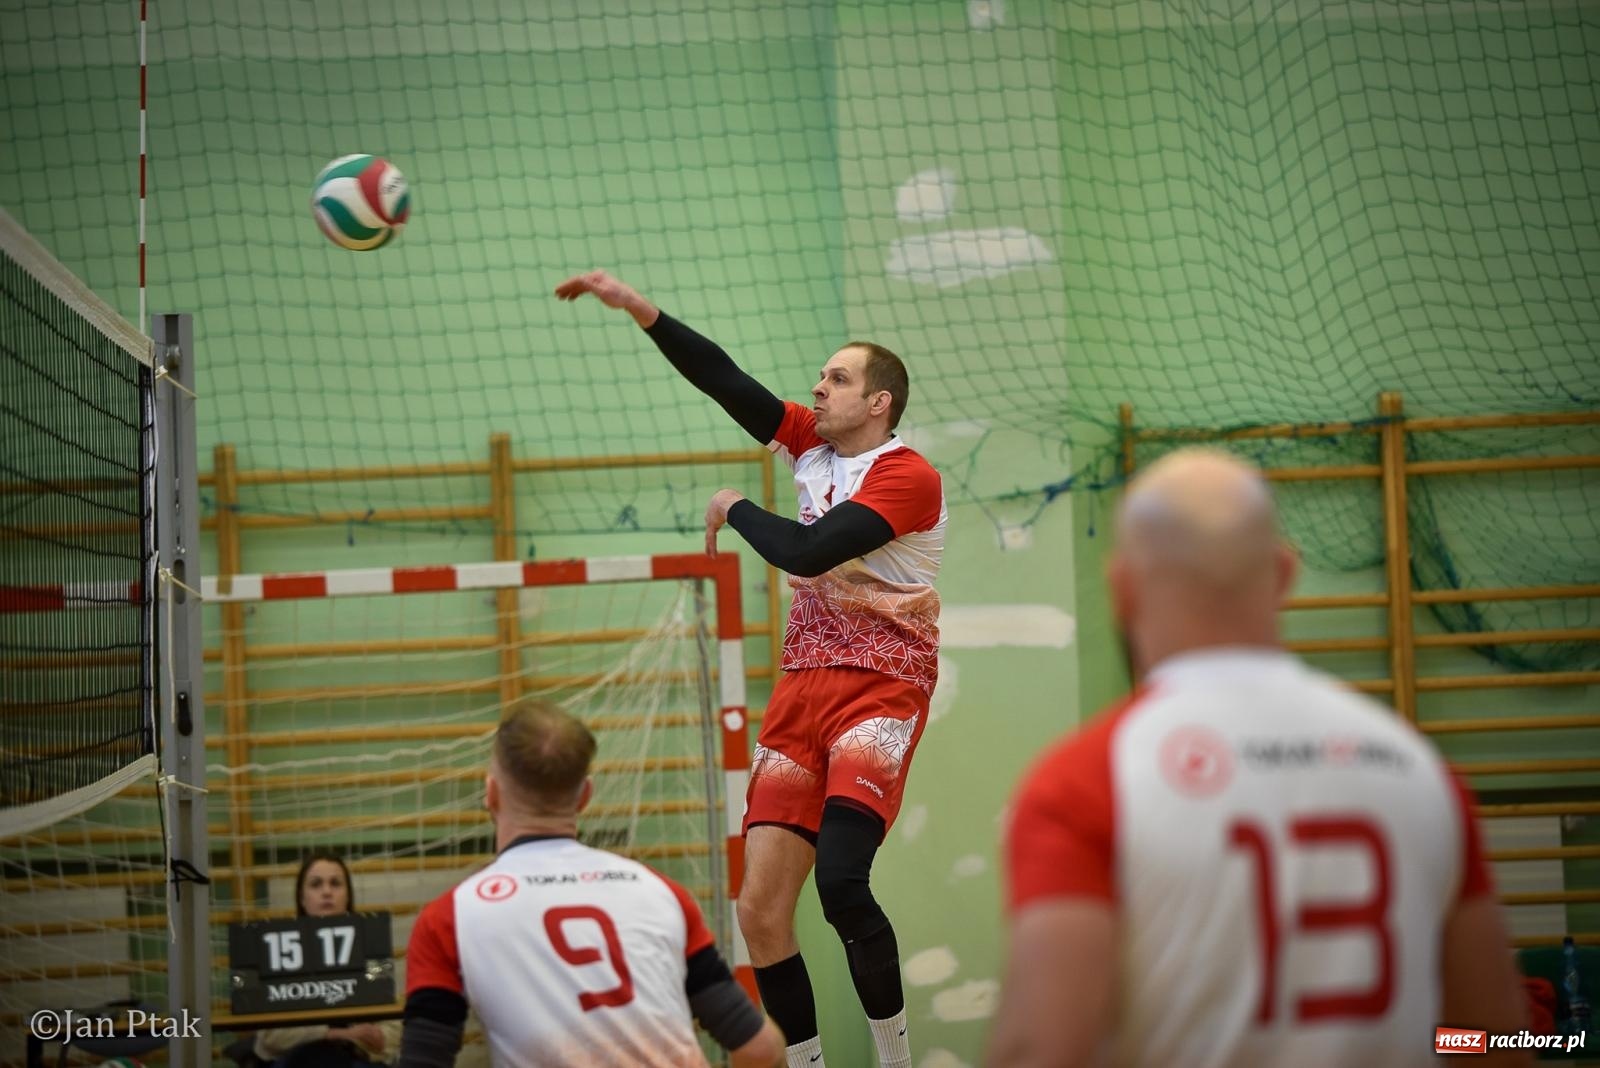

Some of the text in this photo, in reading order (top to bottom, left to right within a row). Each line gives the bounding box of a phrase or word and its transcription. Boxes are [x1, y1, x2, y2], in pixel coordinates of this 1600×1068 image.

[263, 925, 355, 971] 15 17
[1225, 813, 1396, 1027] 13
[267, 978, 357, 1002] MODEST
[543, 905, 635, 1012] 9
